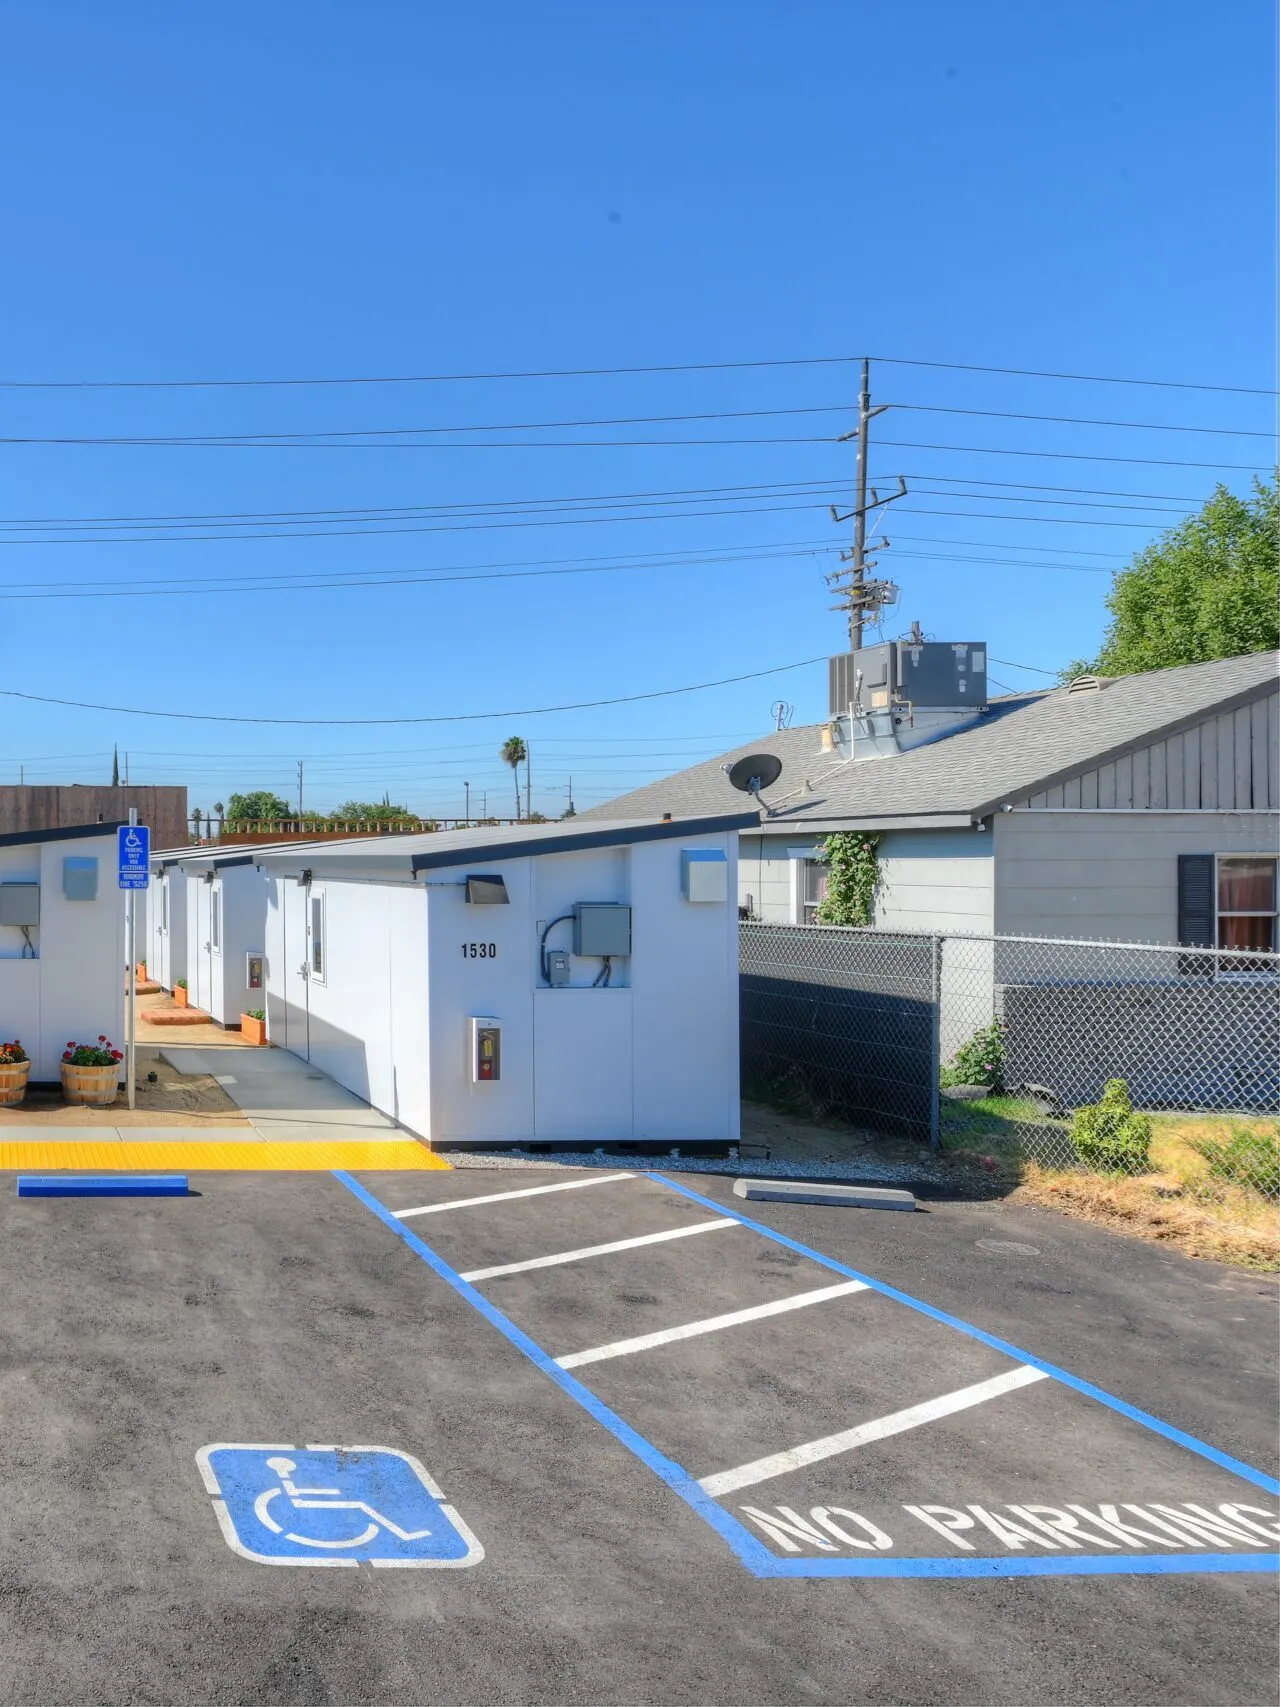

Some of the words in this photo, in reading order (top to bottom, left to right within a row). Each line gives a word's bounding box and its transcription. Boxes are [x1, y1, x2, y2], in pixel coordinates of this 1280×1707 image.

[461, 943, 496, 958] 1530
[738, 1506, 894, 1551] NO
[901, 1504, 1280, 1549] PARKING
